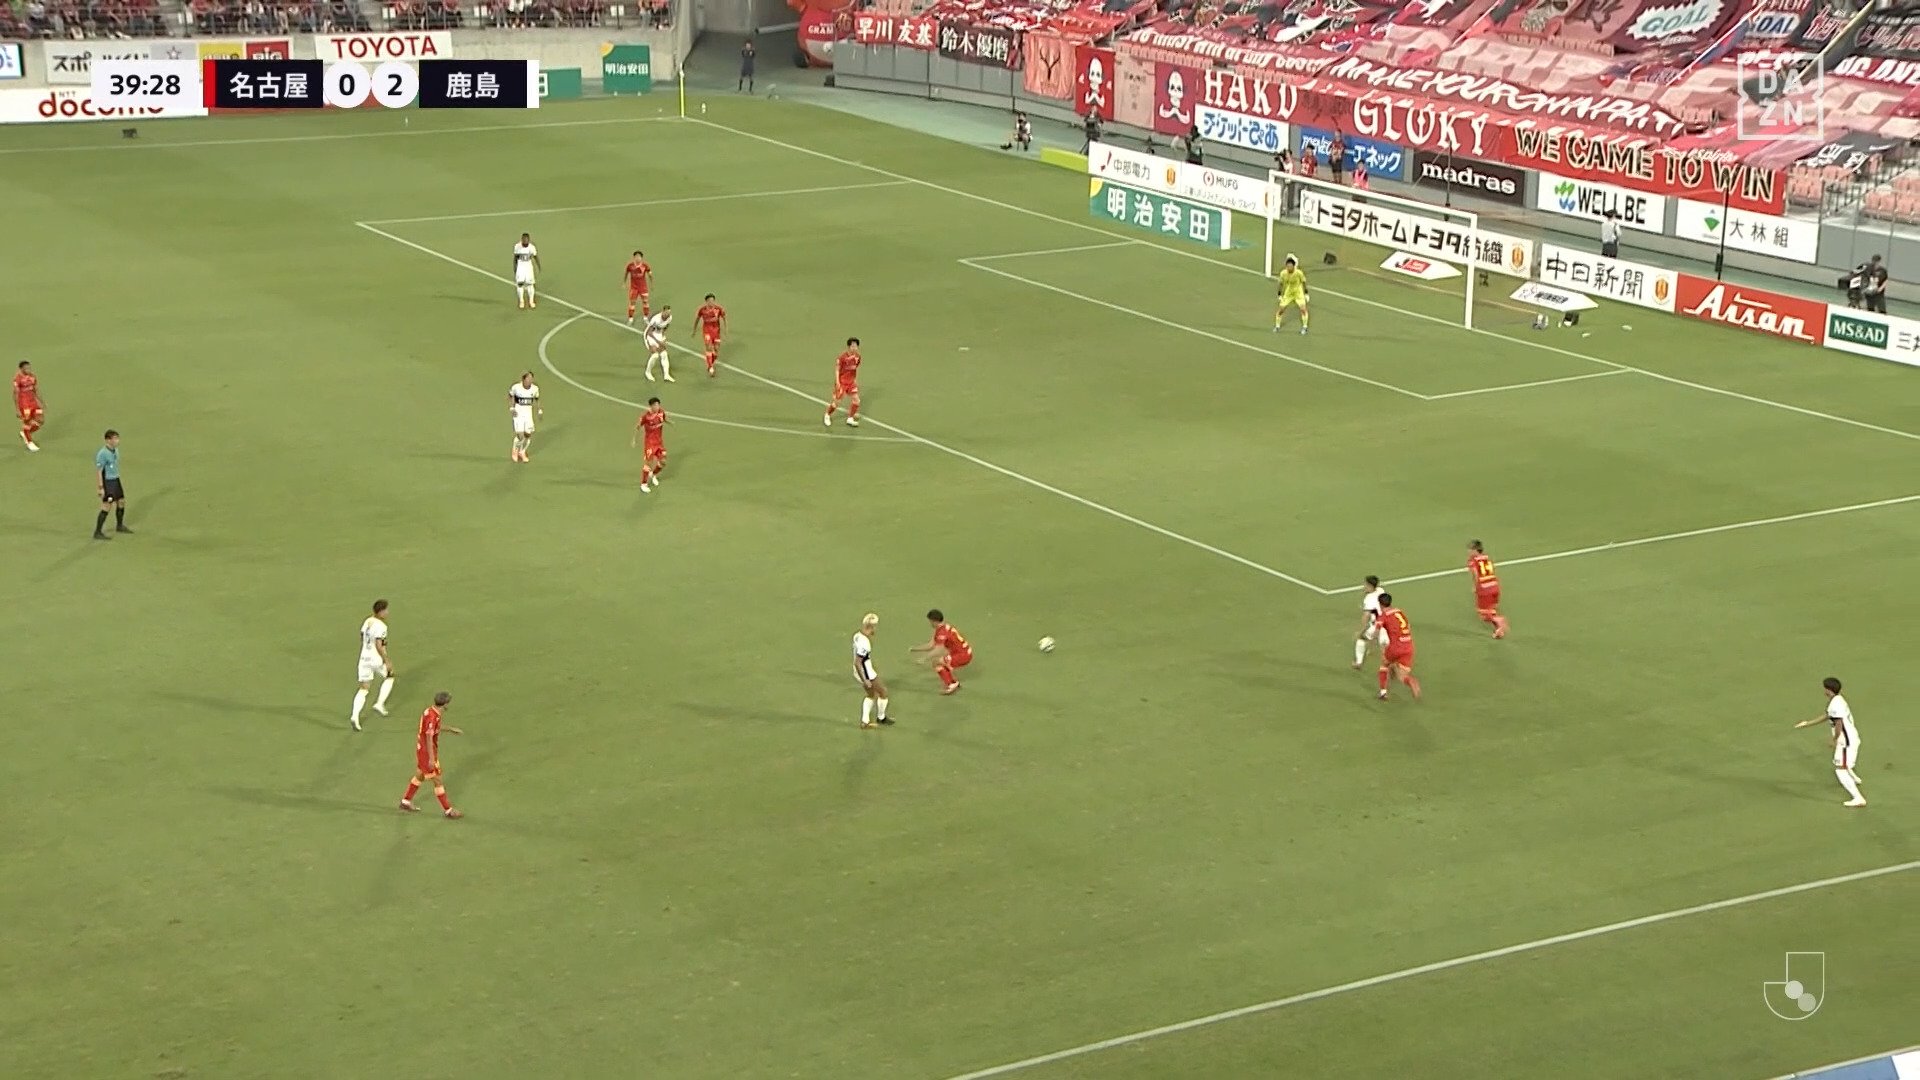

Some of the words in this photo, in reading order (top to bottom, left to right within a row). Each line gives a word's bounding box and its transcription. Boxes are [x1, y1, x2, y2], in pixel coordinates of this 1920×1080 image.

[1642, 4, 1708, 34] GOAL
[330, 34, 438, 60] TOYOTA
[941, 29, 1010, 62] 鈴木優磨
[605, 62, 649, 76] 明治安田
[1203, 110, 1280, 151] チケットぴあ
[1113, 157, 1151, 182] 中部電力
[1421, 161, 1516, 196] madras
[1514, 121, 1562, 165] WE
[1565, 128, 1655, 181] CAME
[1663, 146, 1704, 189] TO
[1711, 158, 1775, 204] WIN
[1215, 174, 1239, 191] MUFG
[1107, 188, 1210, 242] 明治安田
[1577, 185, 1647, 225] WELLBE
[1317, 203, 1407, 245] トヨタホーム
[1729, 217, 1789, 249] 大林組
[1546, 251, 1644, 300] 中日新聞
[1683, 284, 1815, 341] Aisan
[1833, 321, 1885, 344] MS&AD
